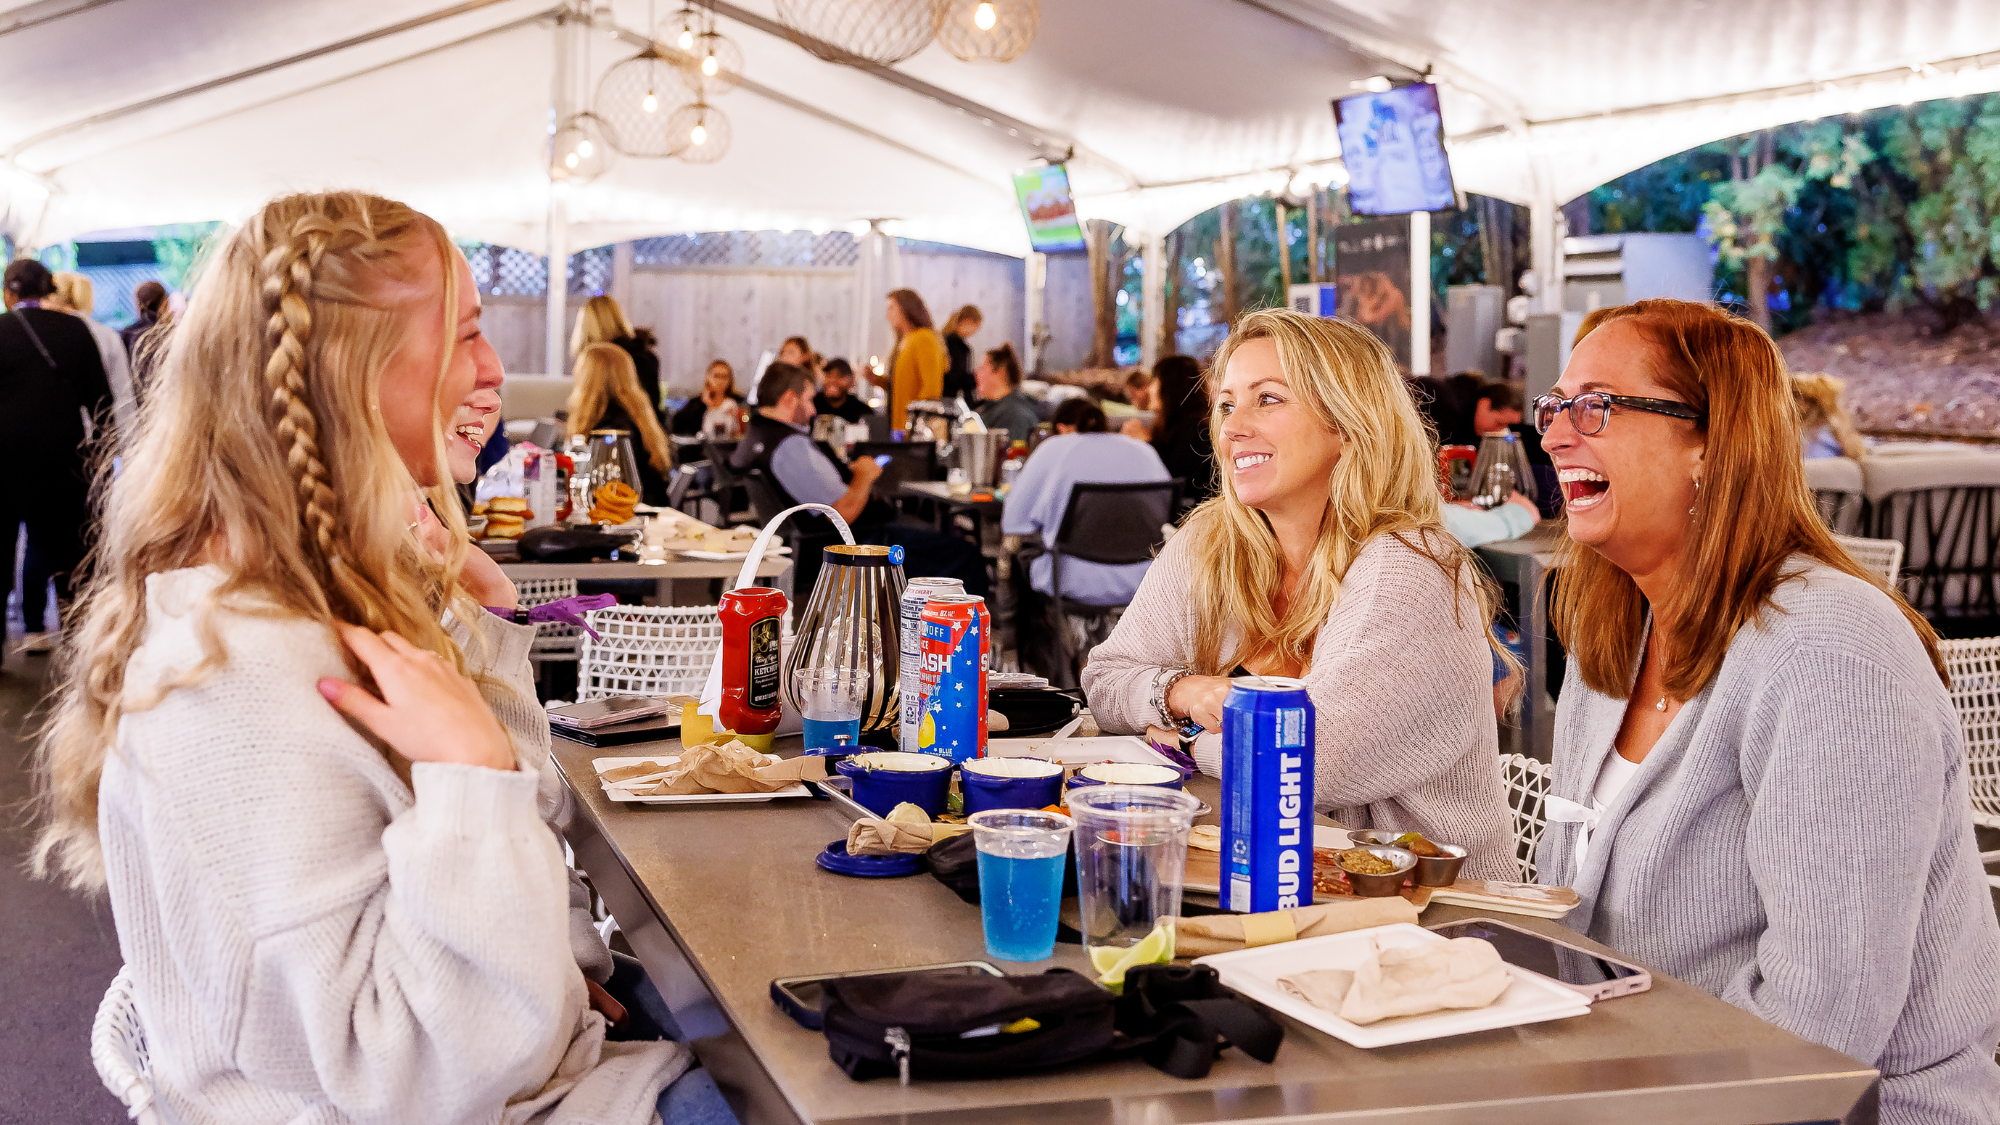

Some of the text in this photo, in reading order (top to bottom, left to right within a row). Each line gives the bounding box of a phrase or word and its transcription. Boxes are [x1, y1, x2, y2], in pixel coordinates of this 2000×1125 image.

[894, 548, 904, 563] 10
[920, 652, 953, 674] ASH
[1278, 752, 1302, 911] BUD LIGHT
